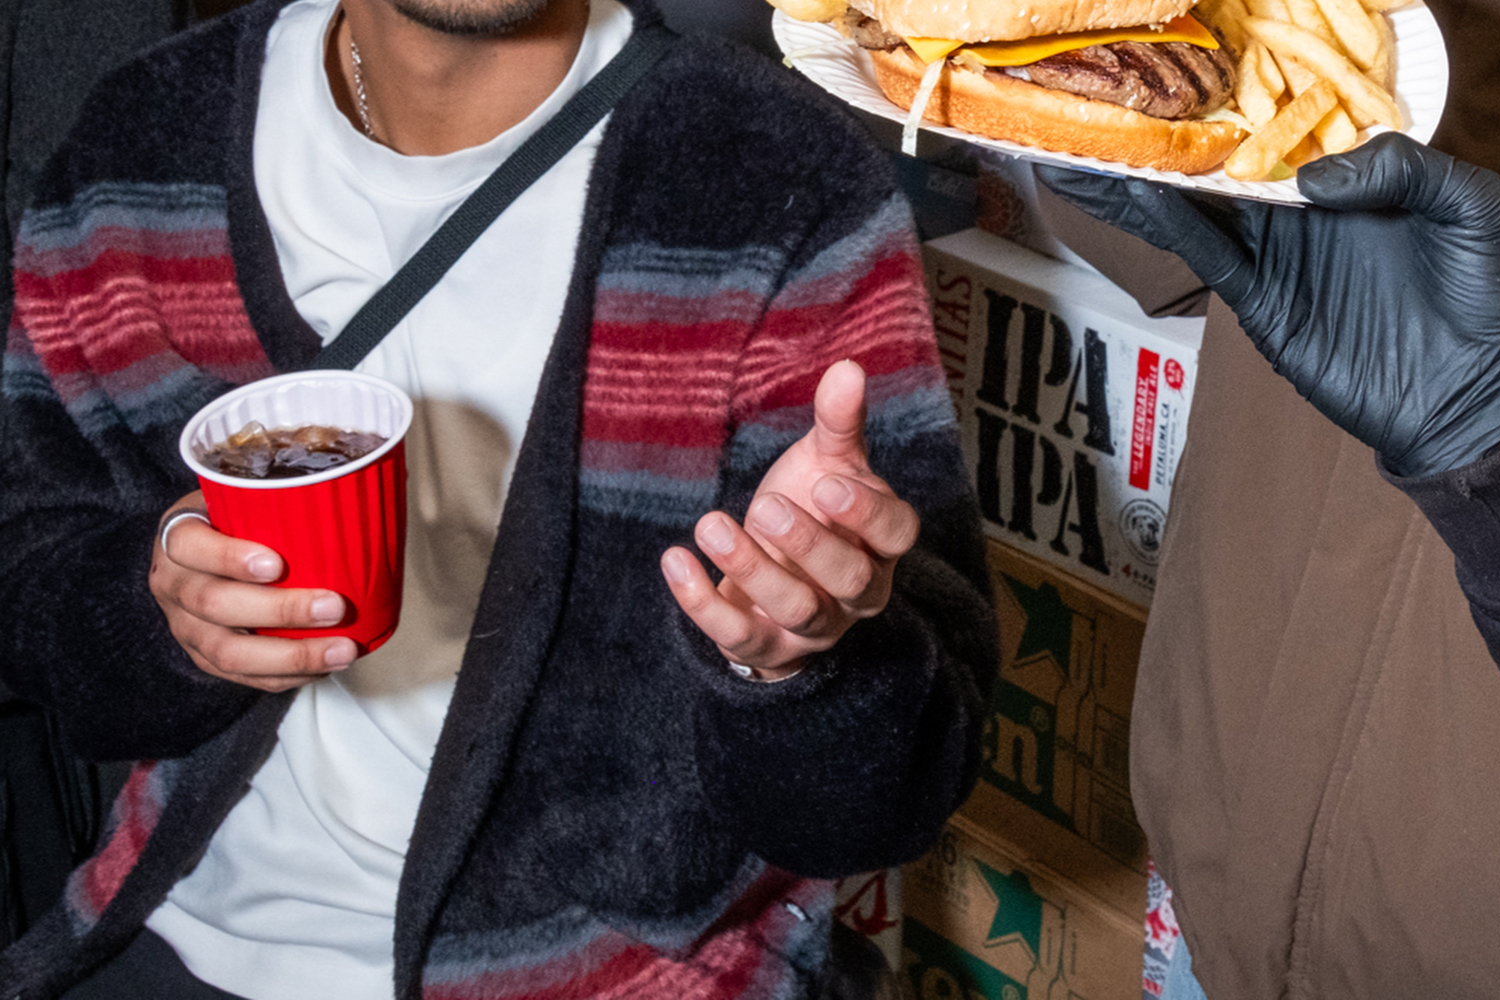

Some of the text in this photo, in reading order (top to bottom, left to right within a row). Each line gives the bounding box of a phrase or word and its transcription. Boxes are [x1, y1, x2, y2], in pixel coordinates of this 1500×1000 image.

[976, 288, 1116, 457] IPA
[1133, 376, 1148, 459] LEGENDARY
[974, 407, 1111, 575] IPA
